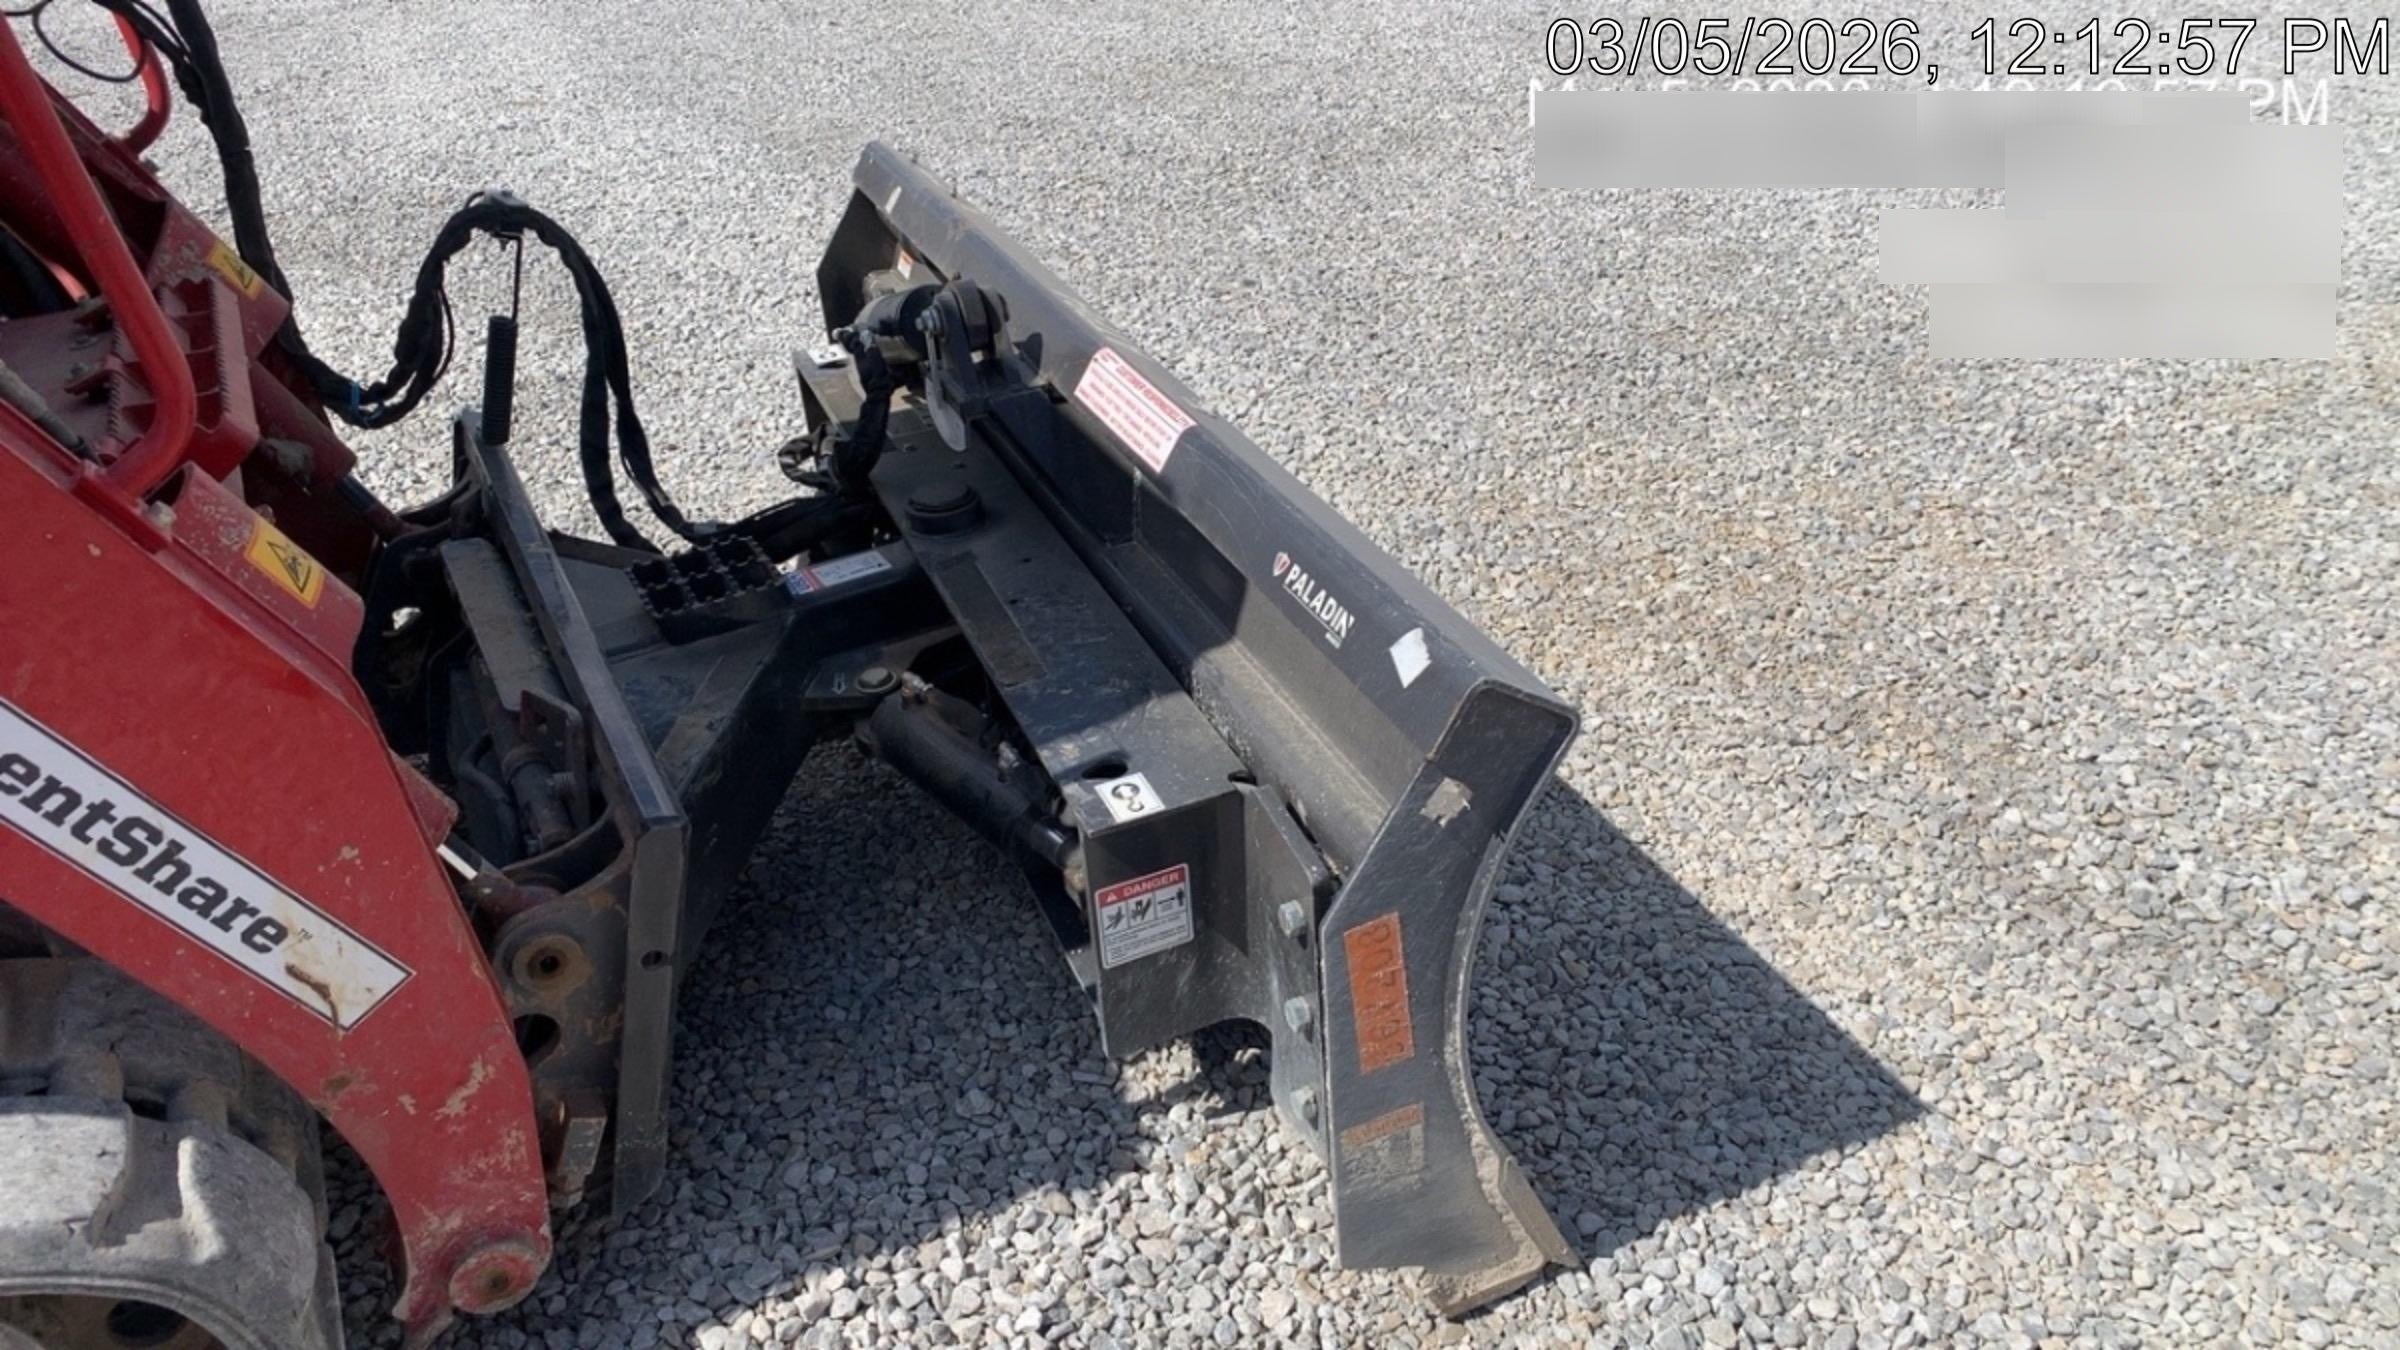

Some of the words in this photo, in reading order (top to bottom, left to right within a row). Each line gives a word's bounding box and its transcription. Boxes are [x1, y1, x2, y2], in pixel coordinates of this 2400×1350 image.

[1284, 563, 1355, 638] PALADIN
[0, 752, 289, 955] entShare
[1123, 871, 1180, 898] DANGER
